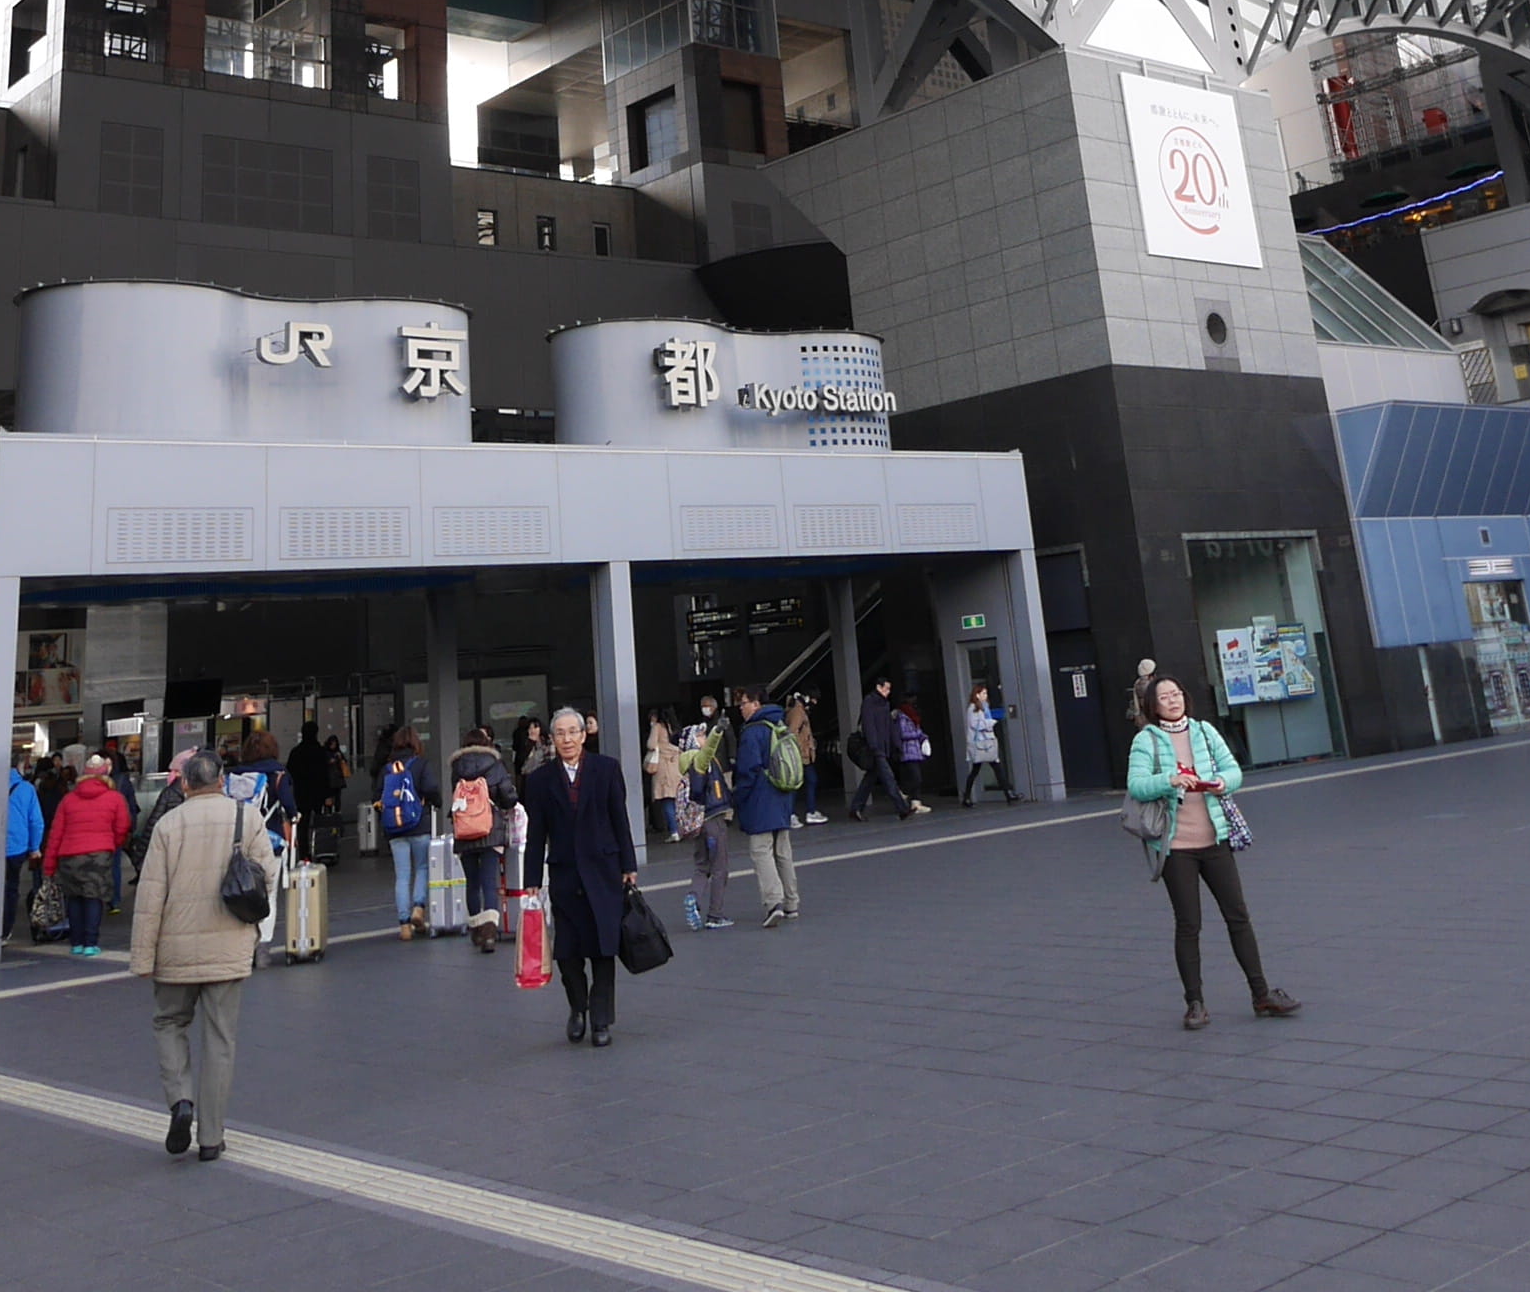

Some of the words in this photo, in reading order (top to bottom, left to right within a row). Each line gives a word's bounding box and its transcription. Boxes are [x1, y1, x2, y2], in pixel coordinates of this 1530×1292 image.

[256, 321, 333, 367] JR
[749, 382, 818, 417] Kyoto
[822, 384, 897, 413] Station
